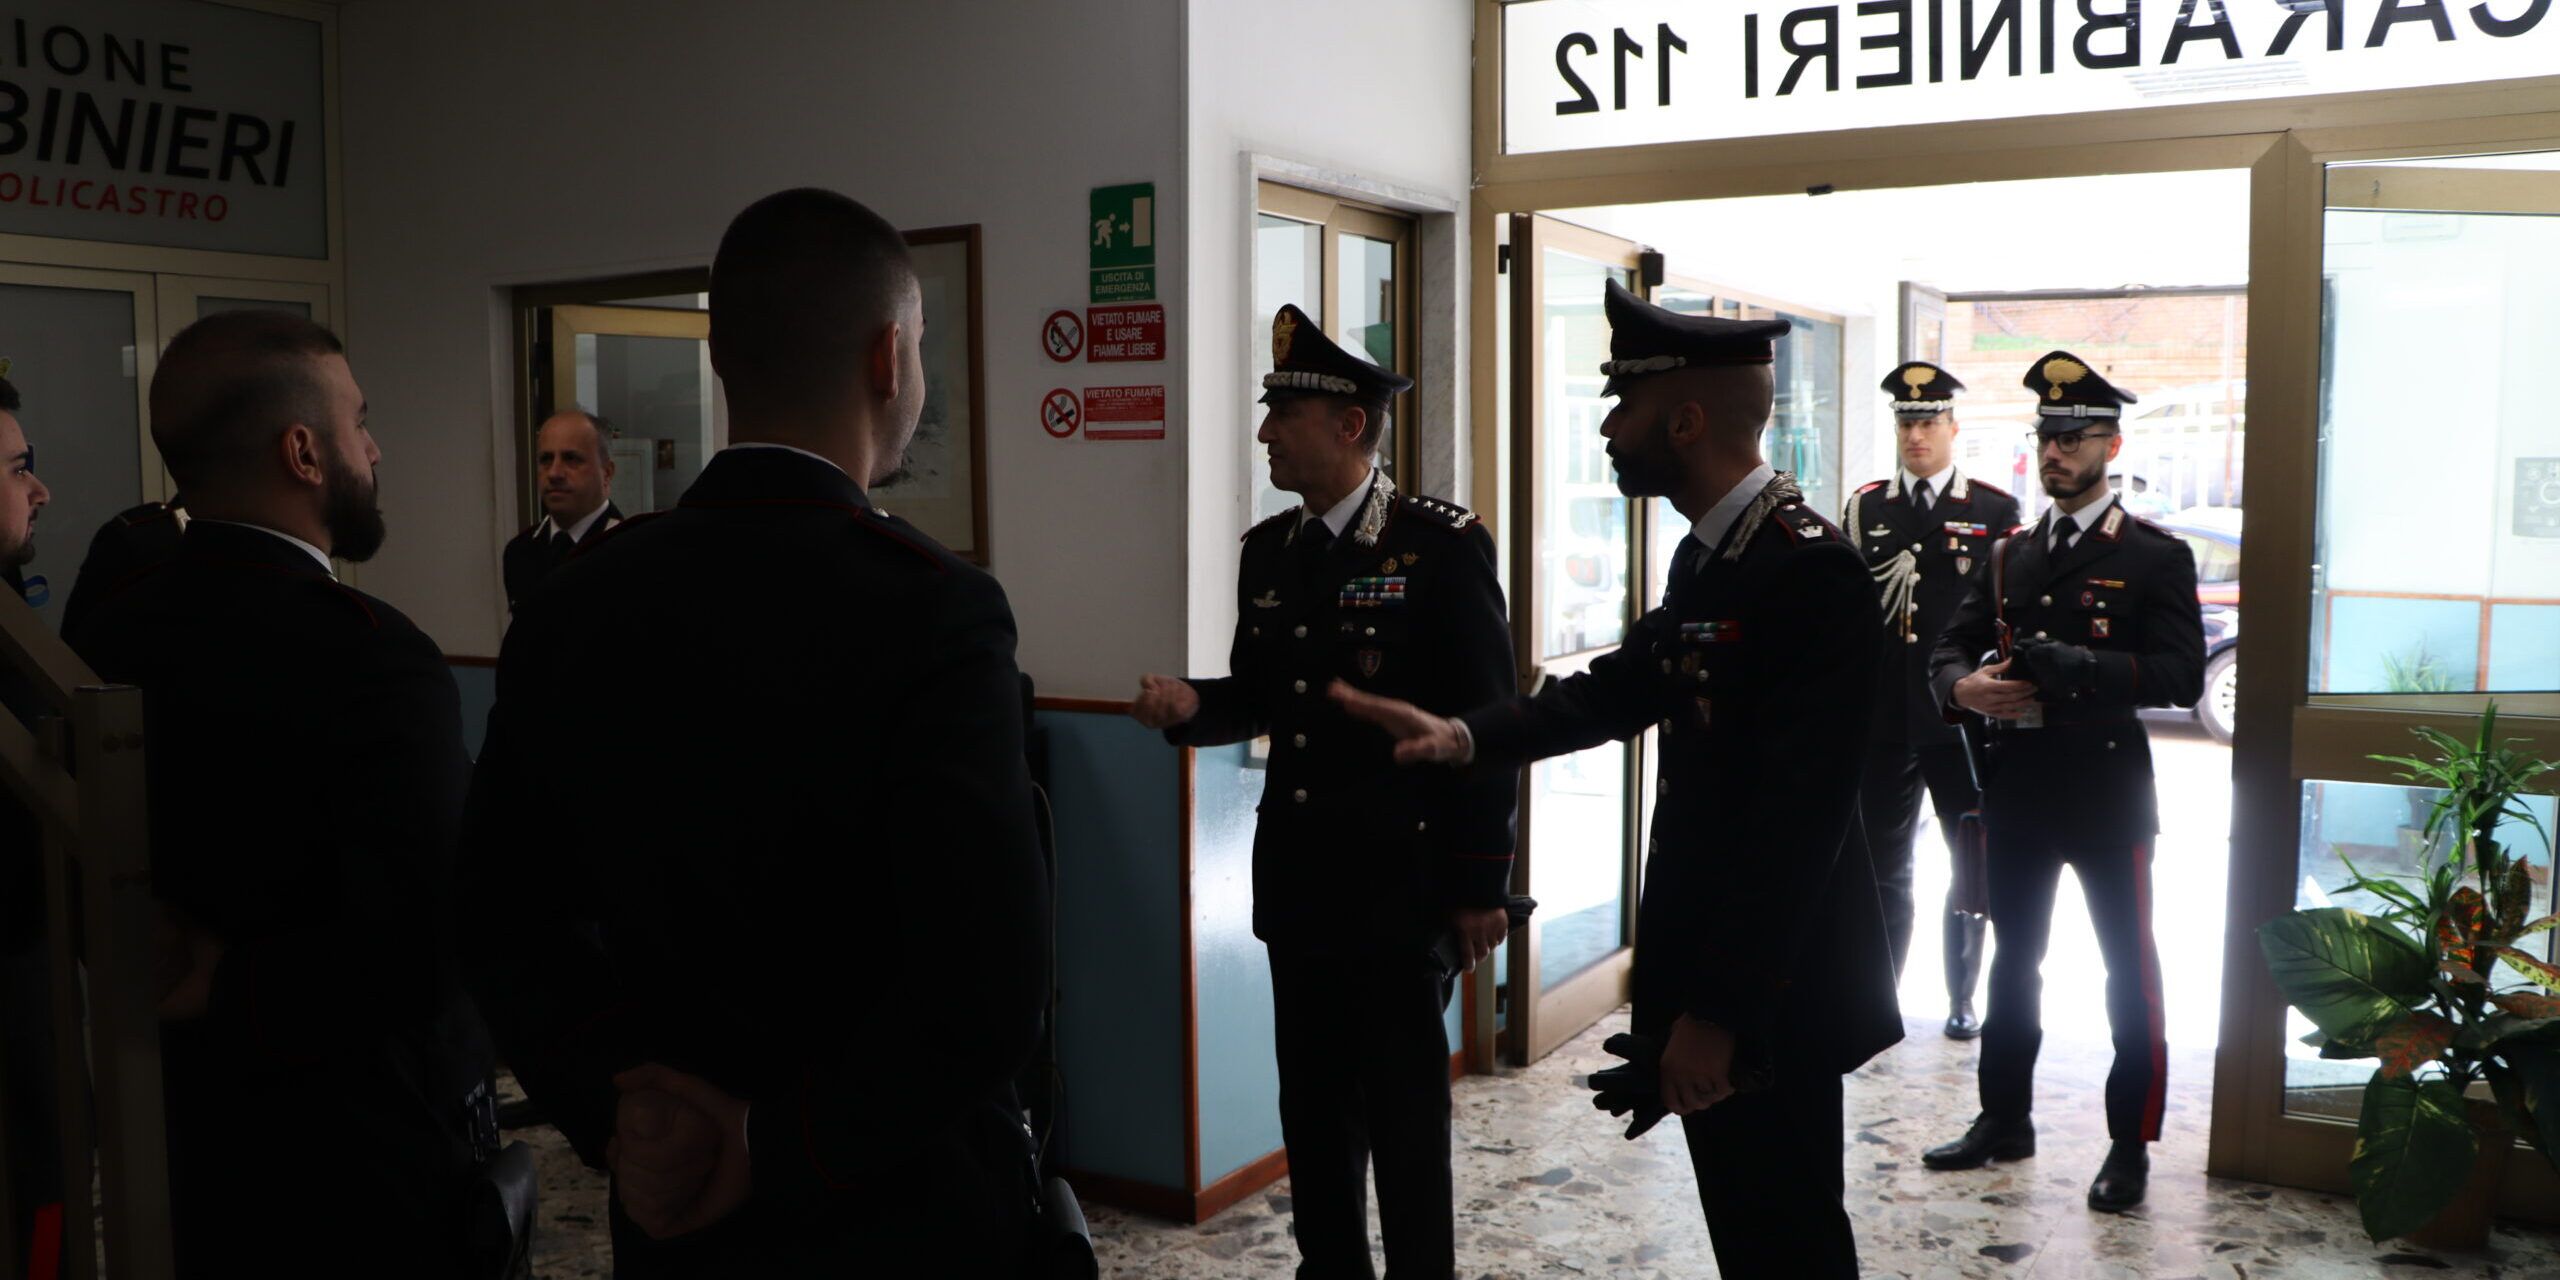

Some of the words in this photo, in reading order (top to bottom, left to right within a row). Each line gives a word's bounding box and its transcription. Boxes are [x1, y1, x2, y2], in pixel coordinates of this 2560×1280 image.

[0, 18, 192, 93] IONE
[1102, 272, 1133, 283] USCITA
[1134, 271, 1145, 281] DI
[1096, 282, 1151, 295] EMERGENZA
[1092, 312, 1125, 327] VIETATO
[1126, 310, 1161, 325] FUMARE
[1106, 328, 1113, 342] E
[1115, 327, 1143, 341] USARE
[1093, 344, 1126, 358] FIAMME
[1128, 342, 1157, 356] LIBERE
[1086, 388, 1122, 399] VIETATO
[1125, 387, 1164, 398] FUMARE
